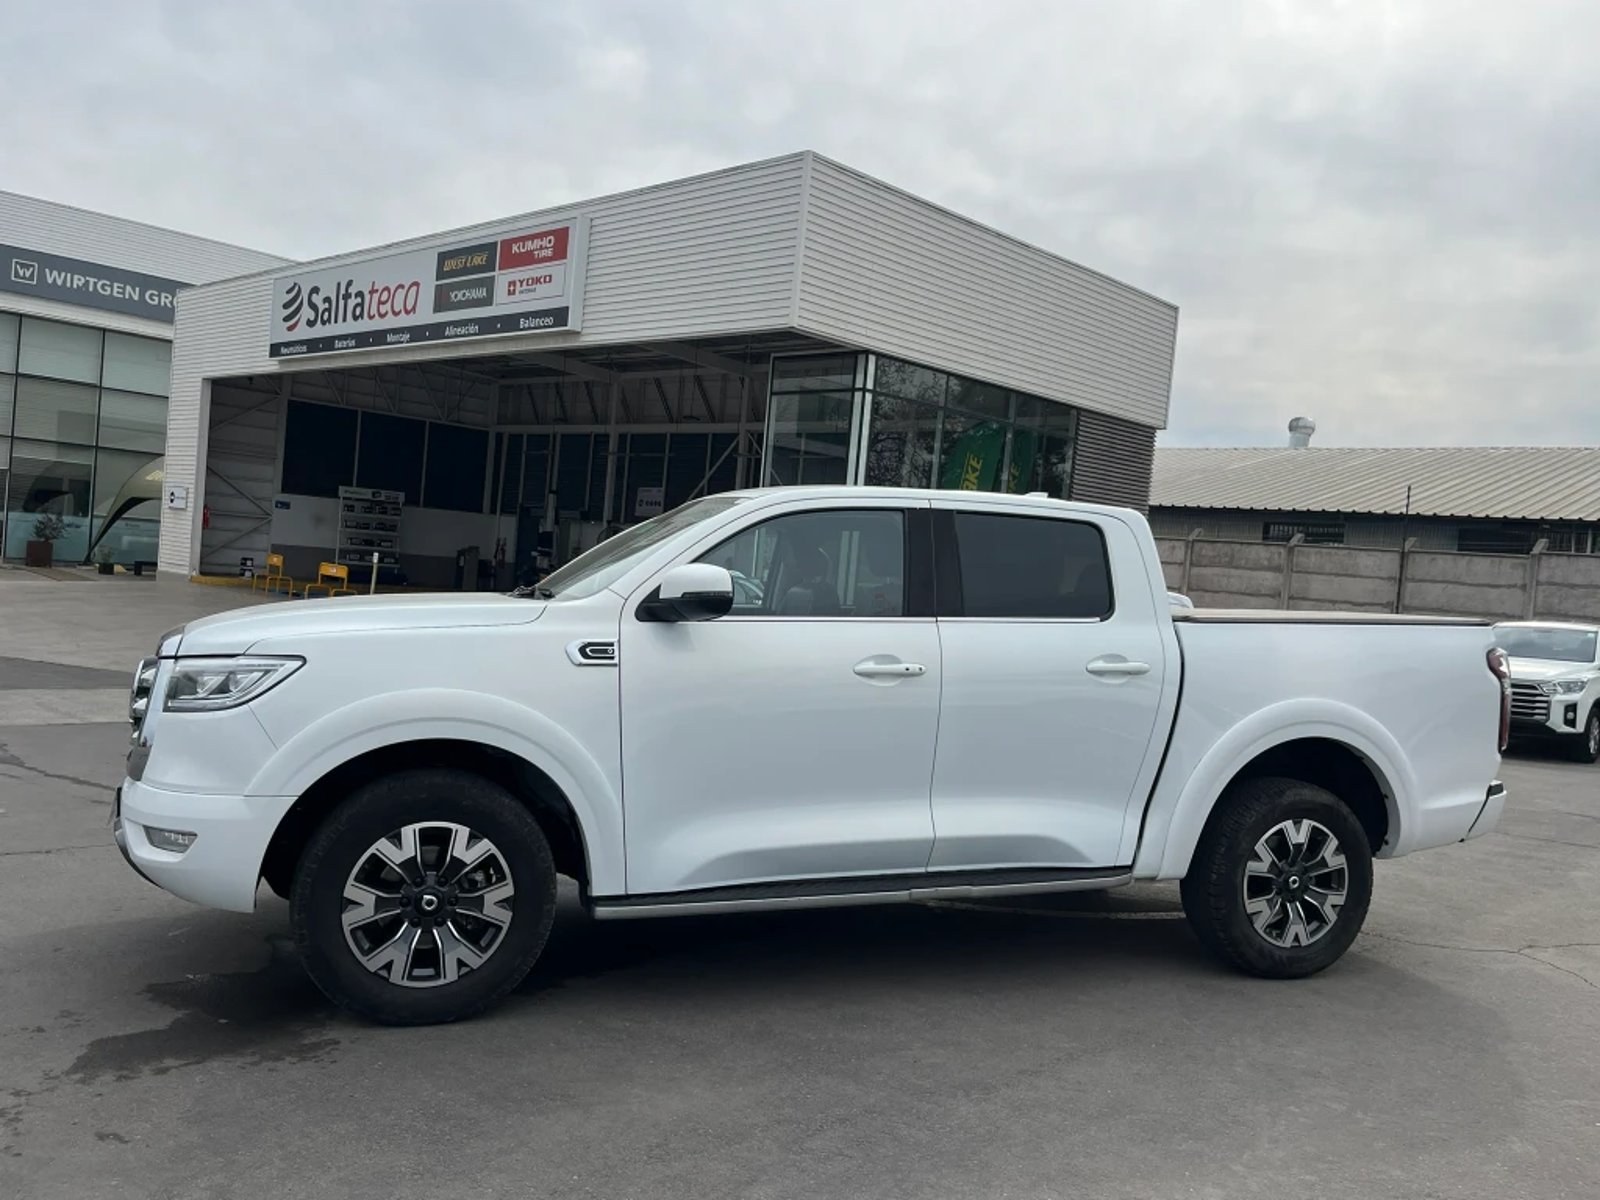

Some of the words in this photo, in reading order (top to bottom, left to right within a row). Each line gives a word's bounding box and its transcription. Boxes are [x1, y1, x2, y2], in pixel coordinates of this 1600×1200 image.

[512, 236, 555, 254] KUMHO
[533, 248, 554, 259] TIRE
[44, 268, 140, 301] WIRTGEN
[519, 274, 553, 288] YOKO
[306, 279, 421, 328] Salfateca
[449, 287, 487, 302] YOKOHAMA
[386, 331, 410, 344] Montaje
[445, 323, 479, 337] Alineación
[520, 316, 554, 329] Balanceo
